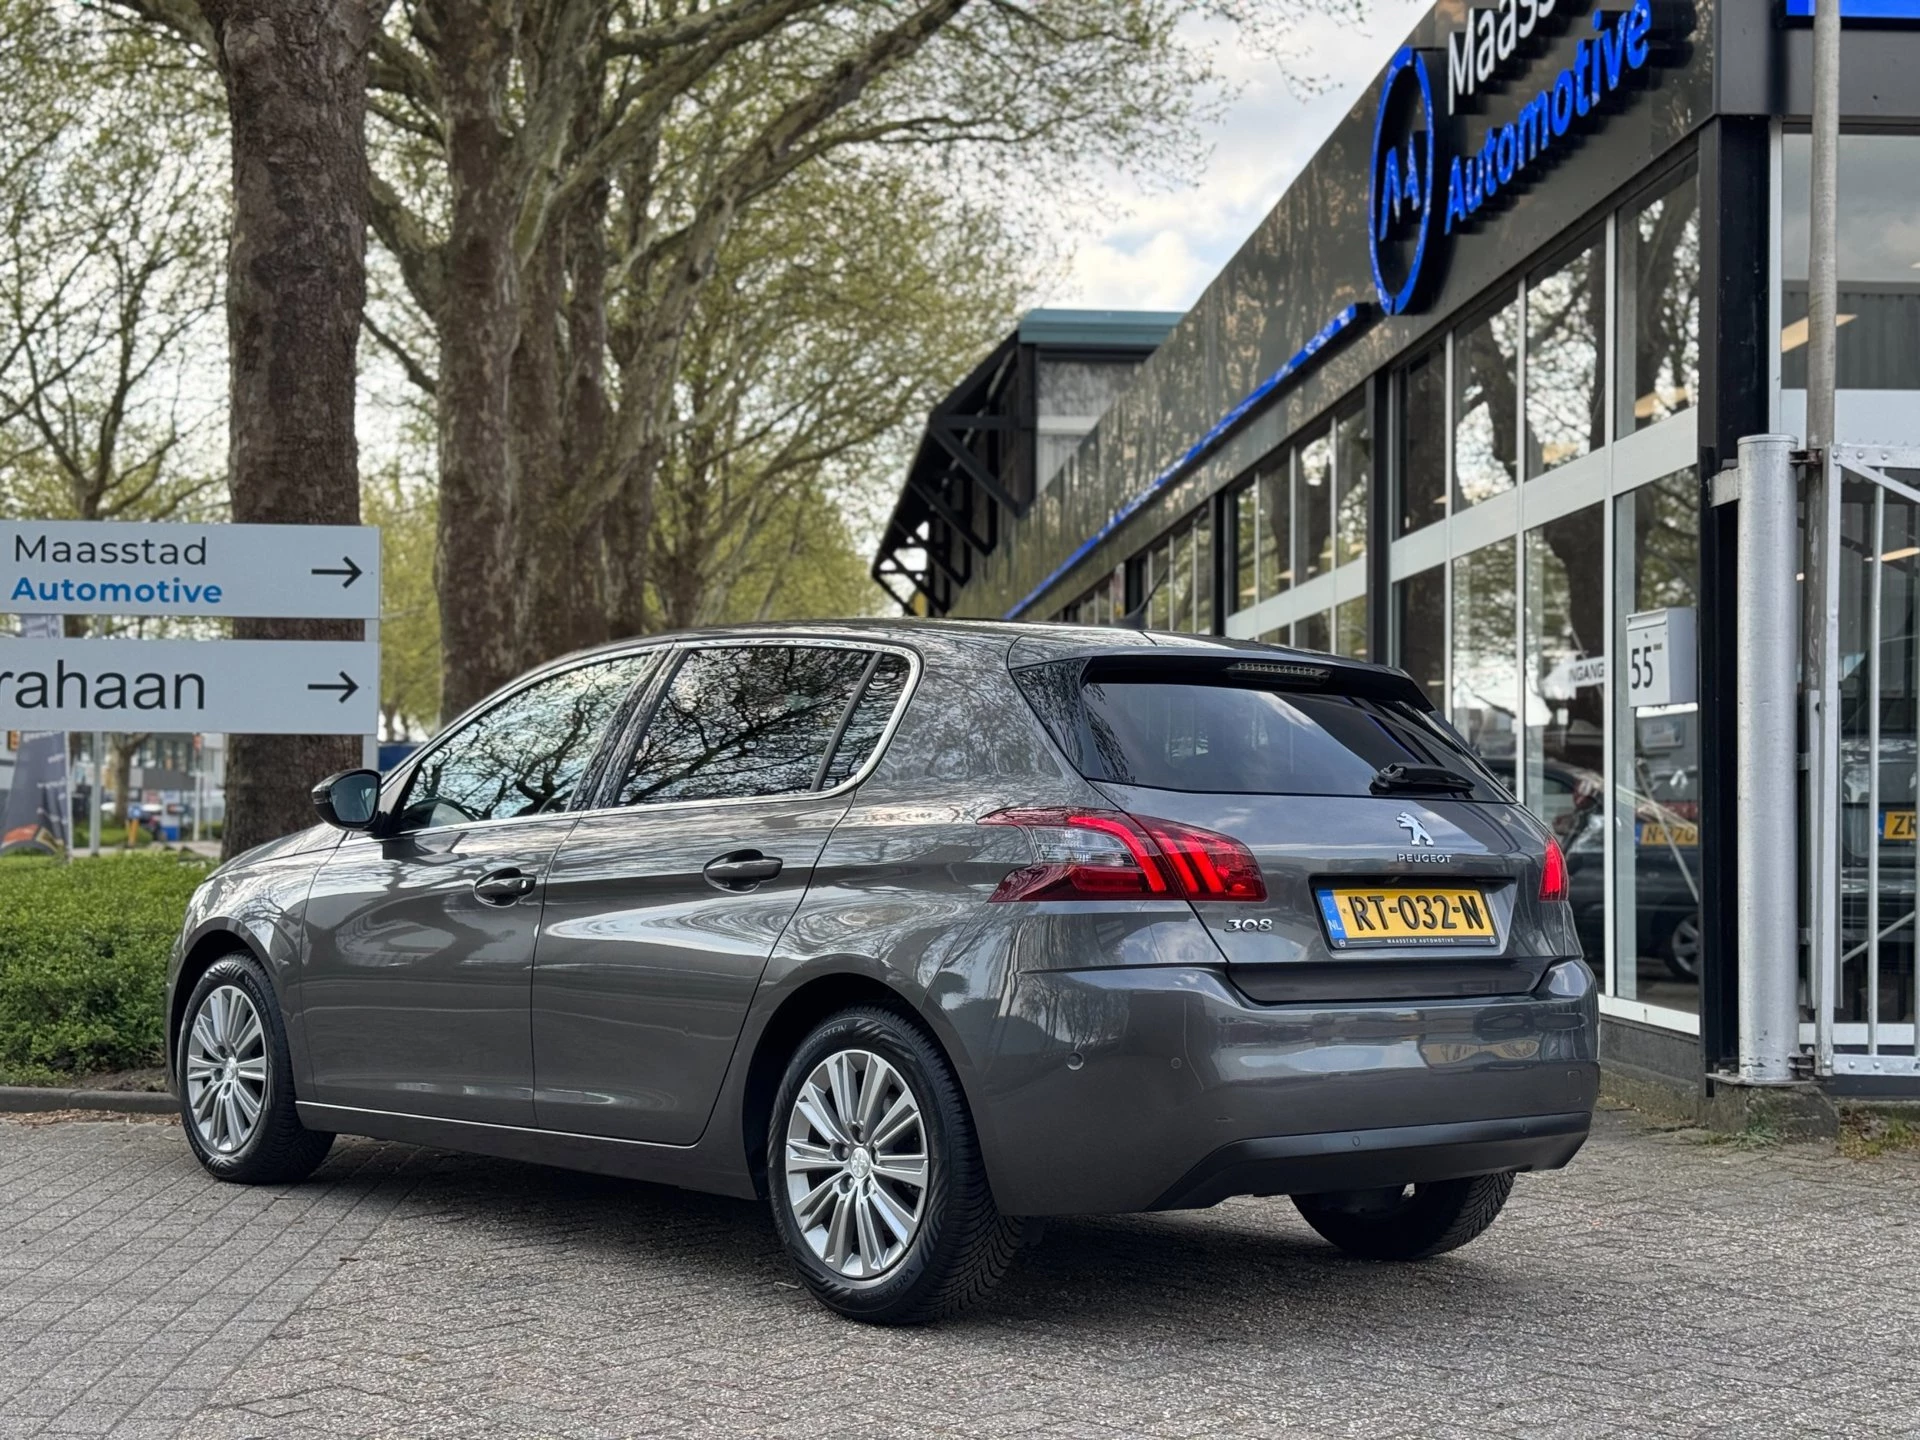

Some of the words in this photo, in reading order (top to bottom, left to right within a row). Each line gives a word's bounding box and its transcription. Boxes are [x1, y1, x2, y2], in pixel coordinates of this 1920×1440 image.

[1444, 0, 1652, 235] Automotive
[15, 534, 207, 565] Maasstad
[11, 577, 222, 603] Automotive
[1631, 646, 1653, 690] 55
[1397, 853, 1452, 864] PEUGEOT
[1224, 918, 1273, 933] 308
[1328, 918, 1342, 932] NL
[1348, 894, 1485, 931] RT-032-N
